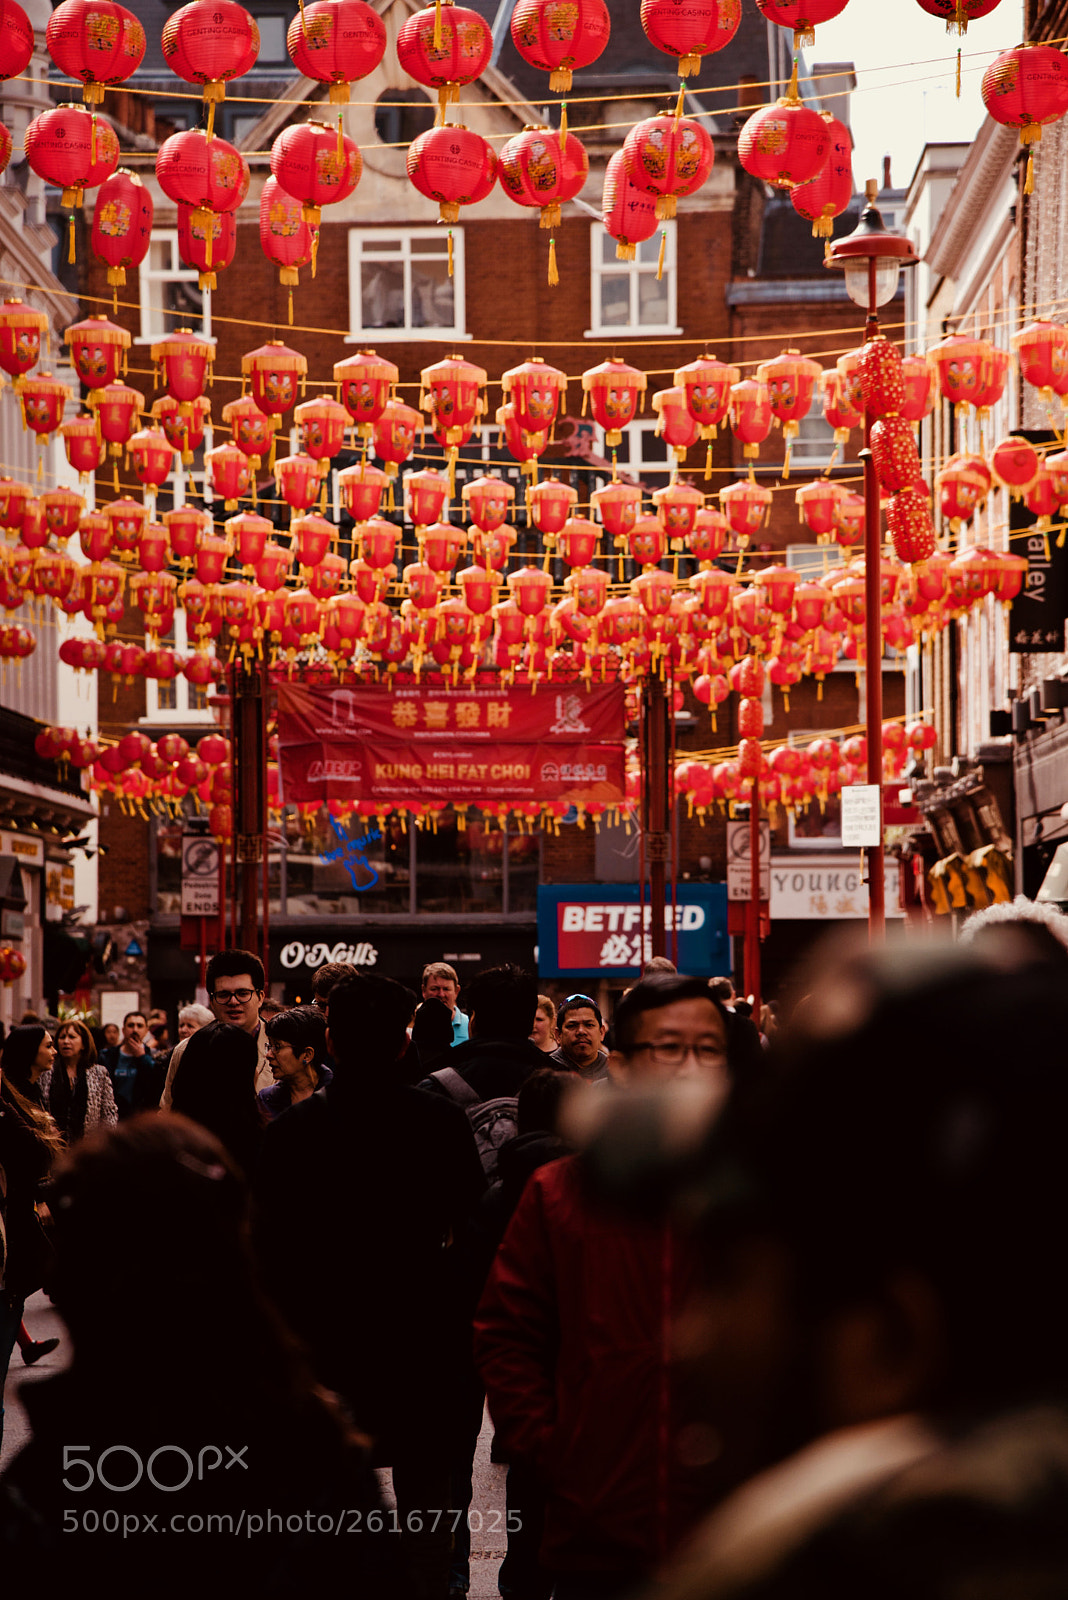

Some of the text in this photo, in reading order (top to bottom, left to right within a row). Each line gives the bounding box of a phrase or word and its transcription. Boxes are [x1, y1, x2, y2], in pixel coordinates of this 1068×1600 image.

[681, 9, 712, 17] CASINO
[186, 27, 222, 37] GENTING
[64, 142, 92, 150] CASINO
[425, 155, 458, 165] GENTING
[391, 701, 513, 728] 恭喜發財
[375, 763, 423, 779] KUNG
[426, 763, 455, 779] HEI
[457, 764, 488, 780] FAT
[490, 764, 531, 780] CHOI
[774, 873, 858, 892] YOUNG
[733, 887, 765, 896] ENS
[187, 902, 220, 912] ENDS
[280, 941, 378, 969] O'Neill's
